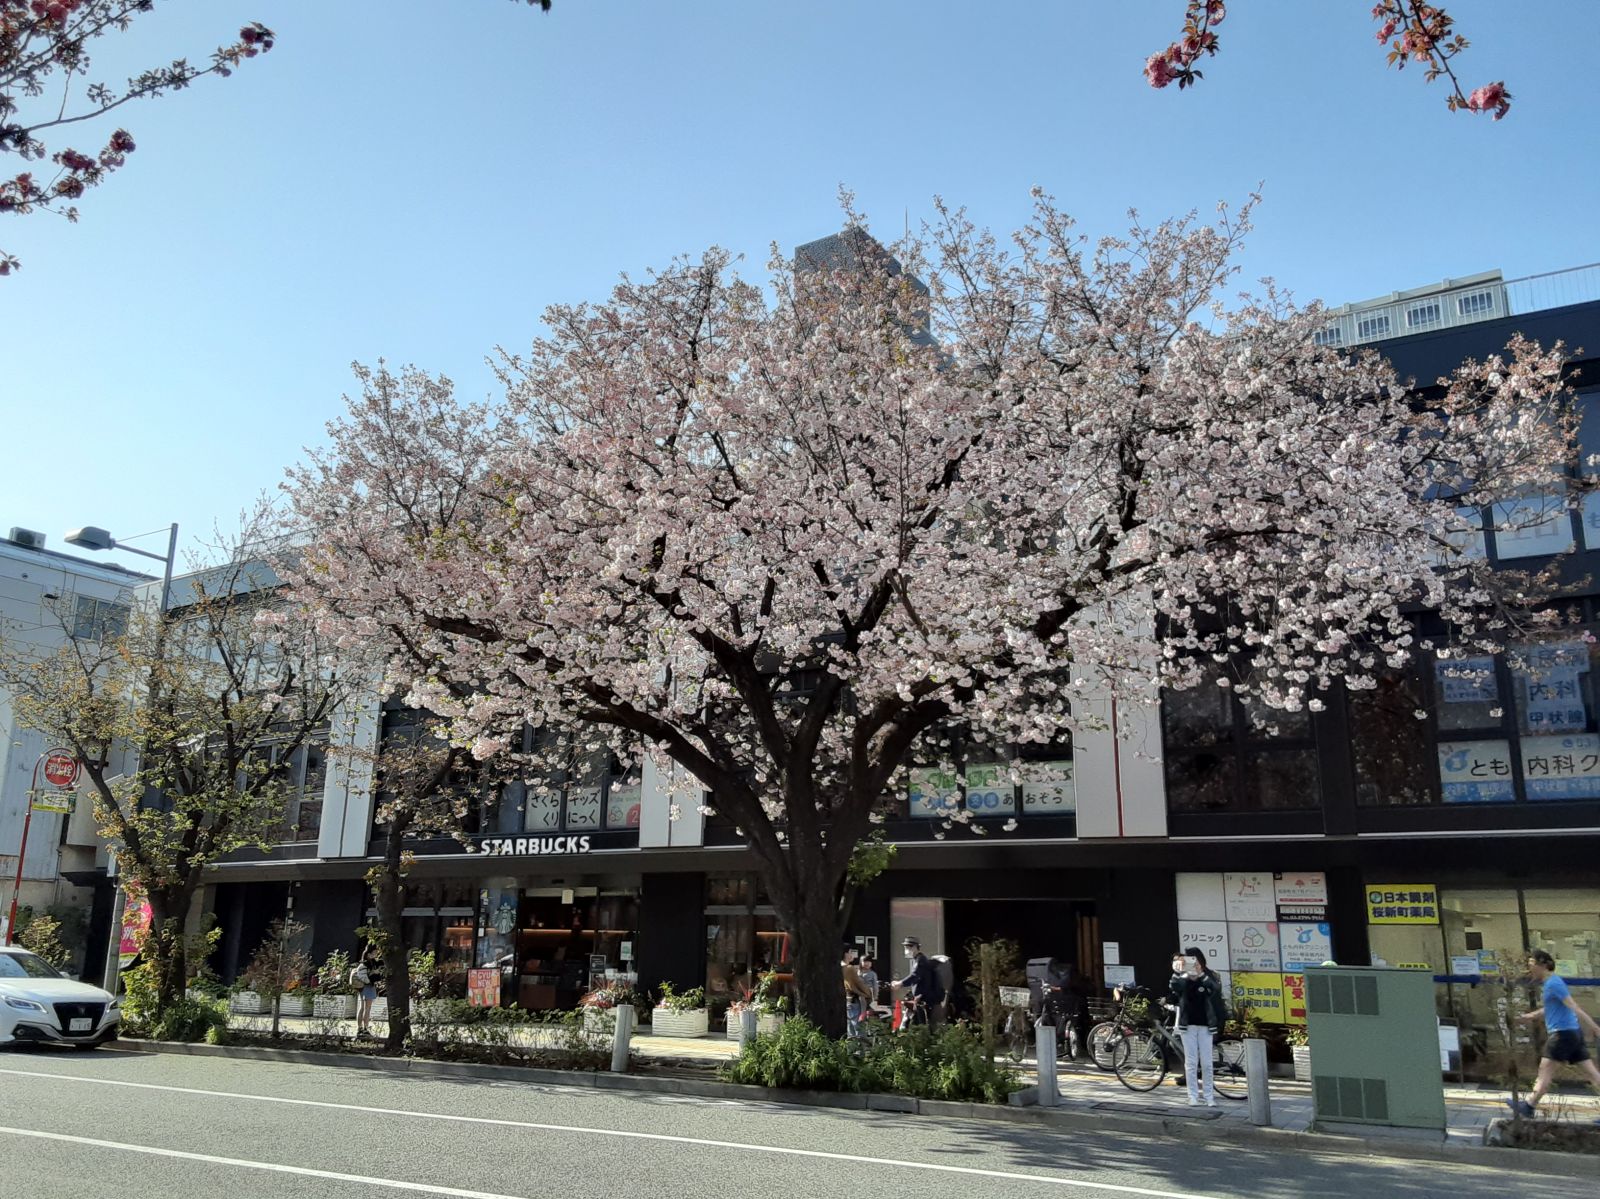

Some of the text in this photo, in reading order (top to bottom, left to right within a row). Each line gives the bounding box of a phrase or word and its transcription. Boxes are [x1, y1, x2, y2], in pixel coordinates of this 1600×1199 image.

[1470, 754, 1598, 777] とも 内科ク
[480, 836, 591, 856] STARBUCKS
[1182, 934, 1223, 942] クリニック
